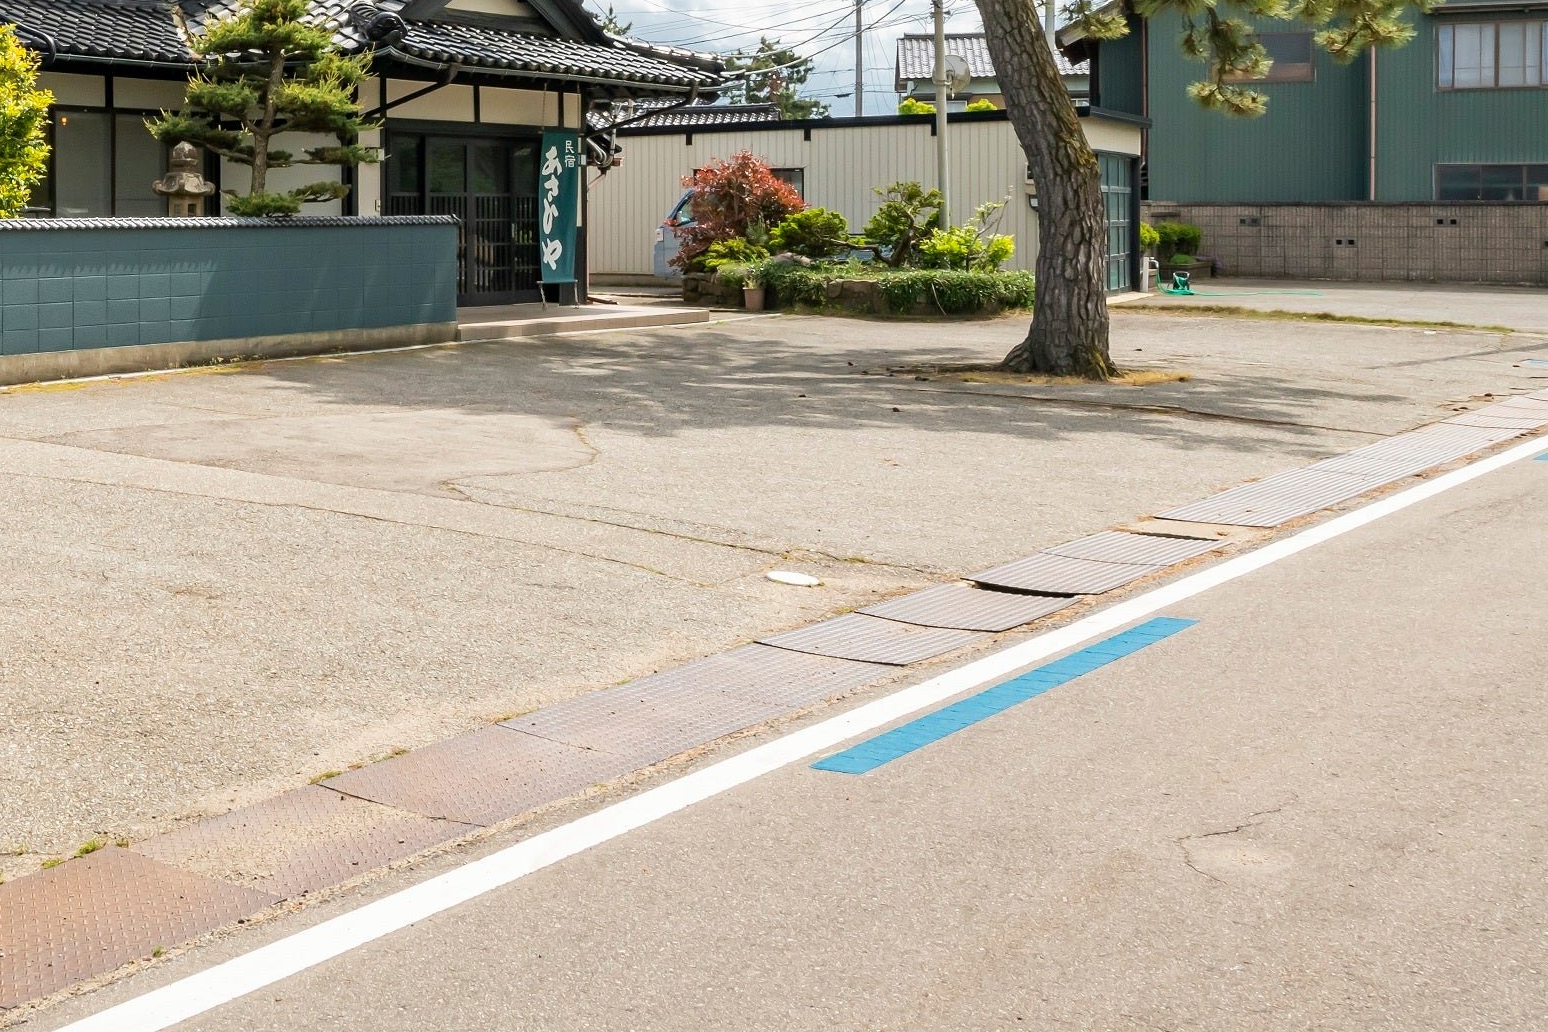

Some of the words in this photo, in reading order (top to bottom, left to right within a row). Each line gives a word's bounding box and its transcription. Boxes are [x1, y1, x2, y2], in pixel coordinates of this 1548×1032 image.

[565, 140, 576, 168] 民宿
[542, 146, 563, 271] あさひや
